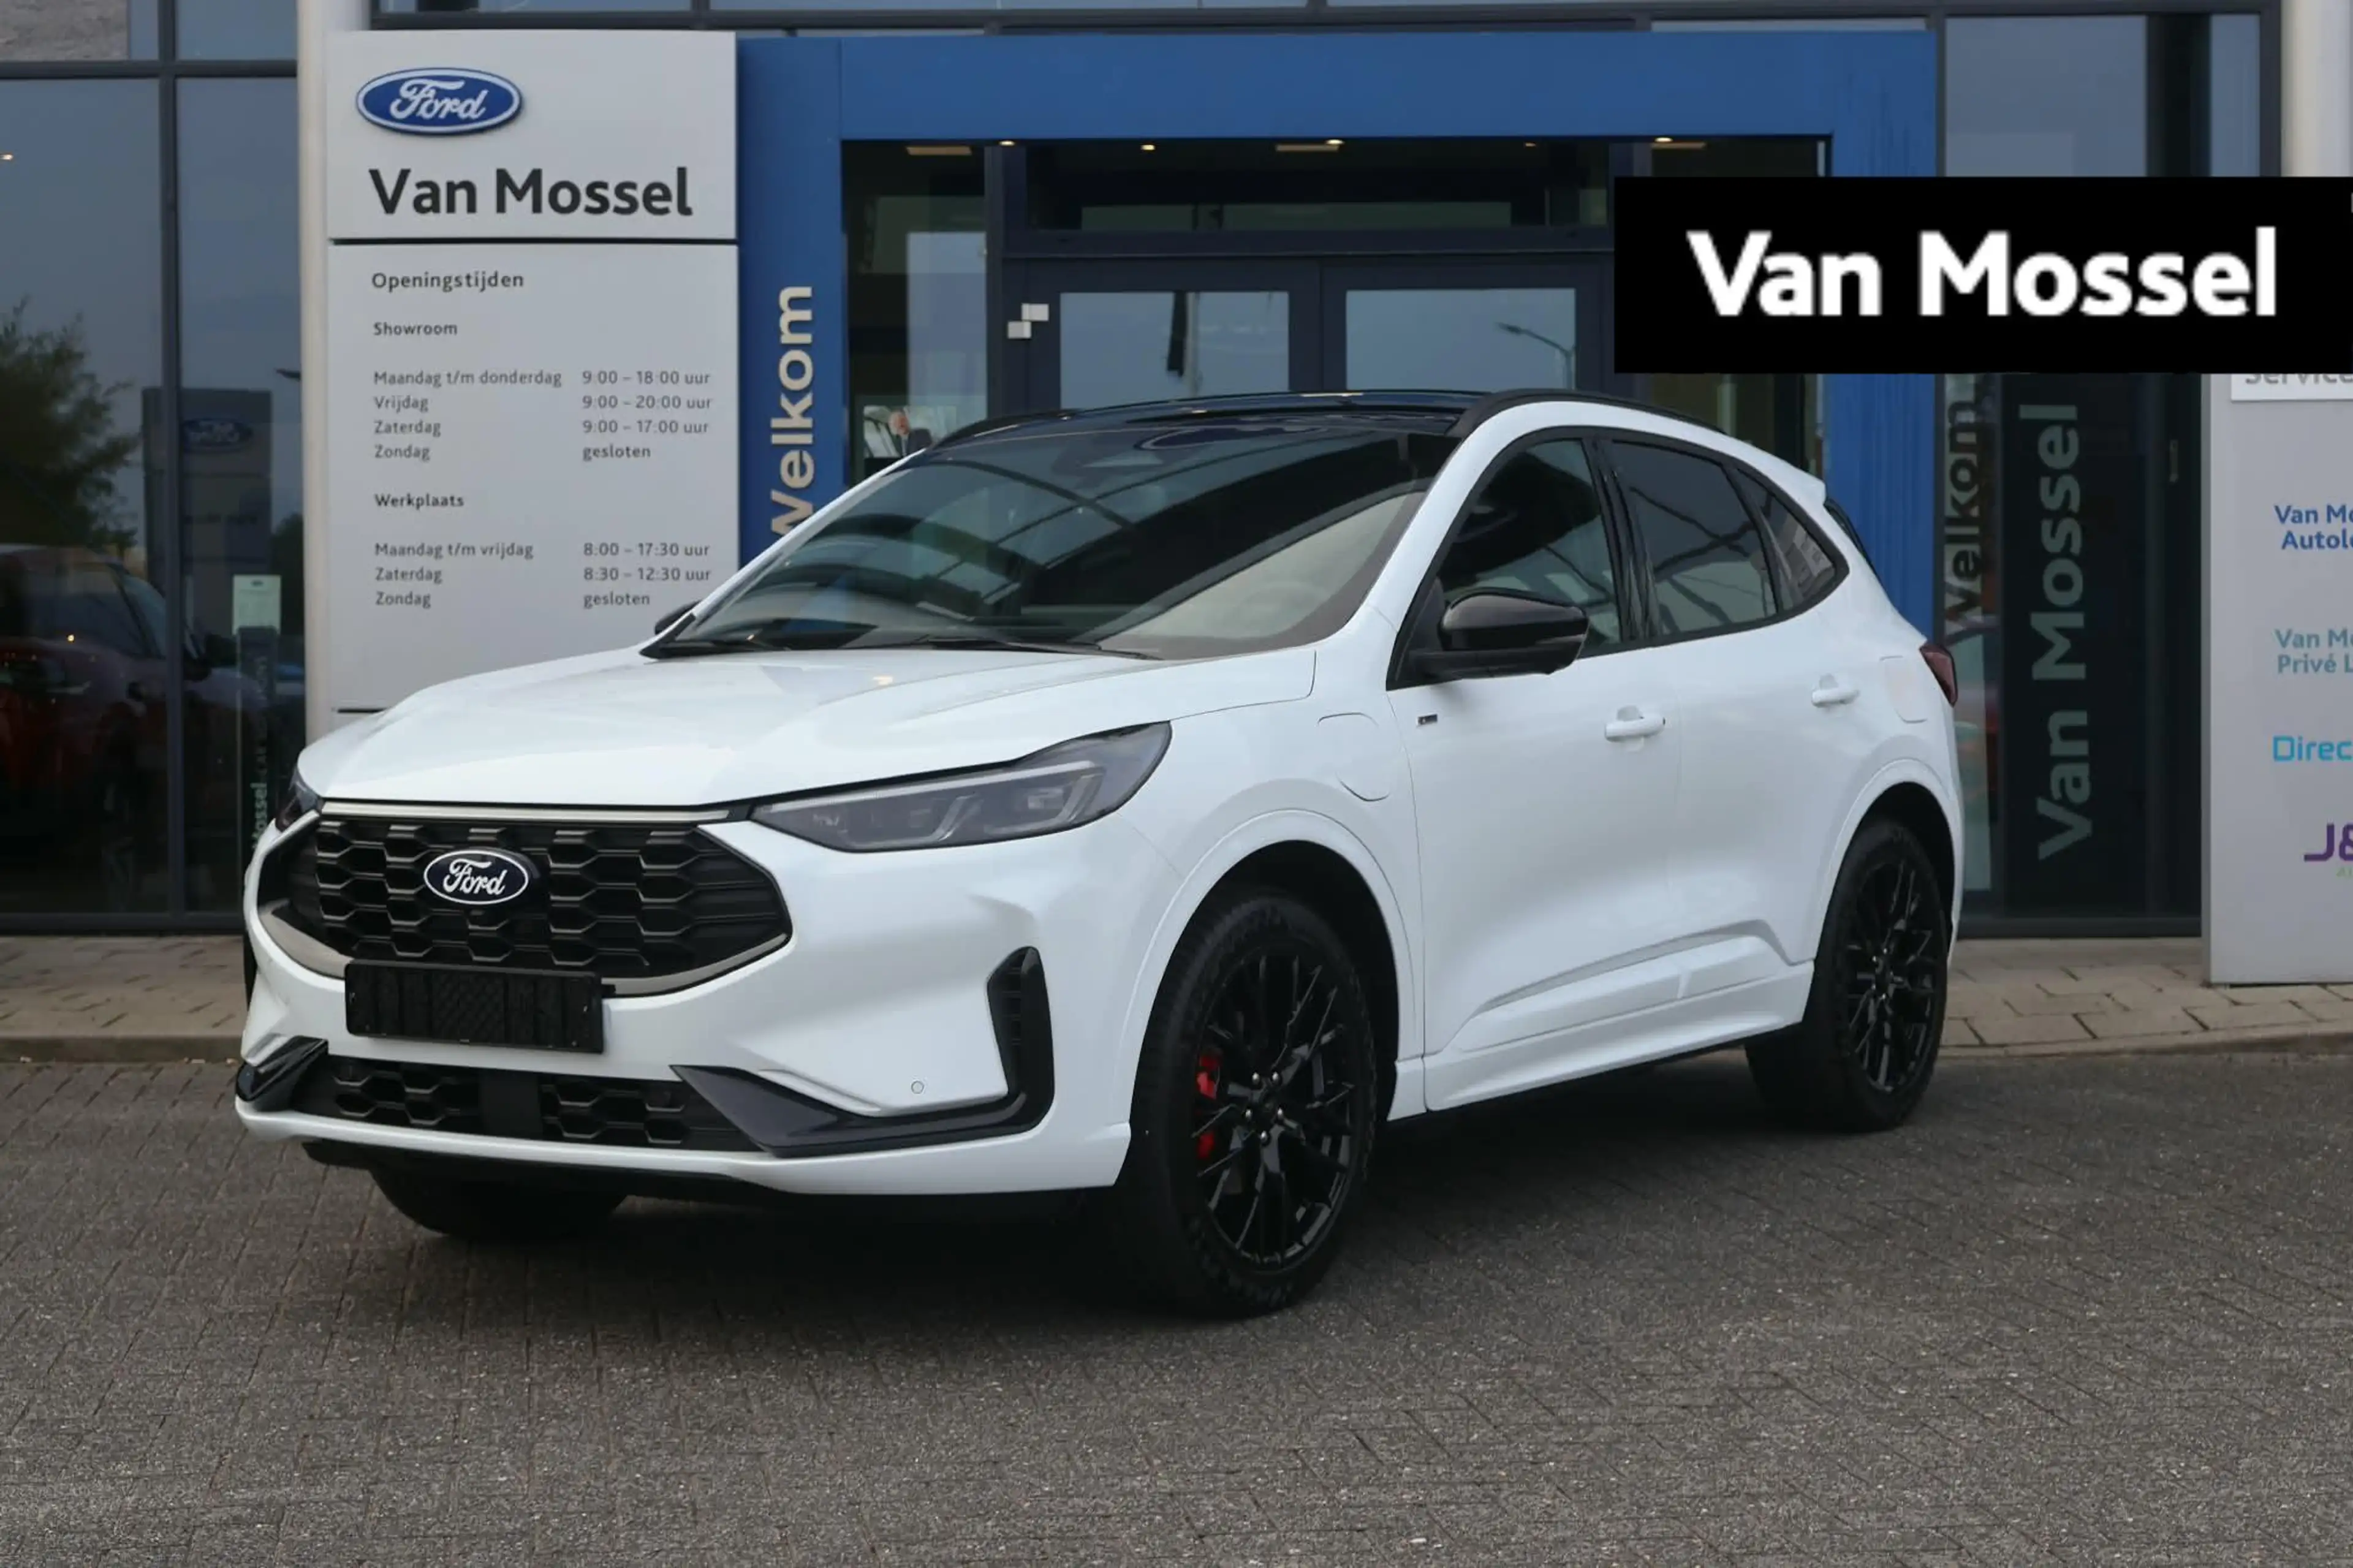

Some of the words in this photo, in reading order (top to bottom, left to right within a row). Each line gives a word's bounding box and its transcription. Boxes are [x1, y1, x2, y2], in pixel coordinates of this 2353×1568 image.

[390, 78, 487, 119] Ford
[368, 169, 477, 214] Van
[496, 167, 693, 216] Mossel
[371, 271, 524, 293] Openingstijden
[373, 322, 458, 336] Showroom
[374, 370, 442, 388] Maandag
[446, 370, 474, 385] t/m
[479, 370, 562, 388] donderdag
[684, 374, 711, 385] uur
[374, 395, 429, 414] Vrijdag
[686, 398, 711, 409] uur
[374, 419, 441, 437] Zaterdag
[683, 423, 708, 434] uur
[374, 444, 431, 463] Zondag
[582, 444, 651, 462] gesloten
[374, 493, 464, 510] Werkplaats
[2274, 505, 2319, 525] Van
[2326, 504, 2353, 525] M
[2020, 404, 2087, 681] Mossel
[2281, 528, 2353, 550] Autol
[374, 542, 444, 560] Maandag
[447, 542, 476, 556] t/m
[480, 542, 534, 560] vrijdag
[583, 542, 620, 556] 8:00
[638, 542, 680, 556] 17:30
[684, 546, 710, 556] uur
[375, 566, 443, 585] Zaterdag
[583, 567, 620, 581] 8:30
[637, 567, 681, 581] 12:30
[685, 570, 711, 581] uur
[375, 591, 431, 610] Zondag
[583, 591, 650, 610] gesloten
[2275, 629, 2320, 649] Van
[2327, 627, 2353, 648] M
[2278, 653, 2337, 674] Privé
[2273, 735, 2353, 762] Direc
[2035, 710, 2093, 860] Van
[443, 858, 508, 895] Ford
